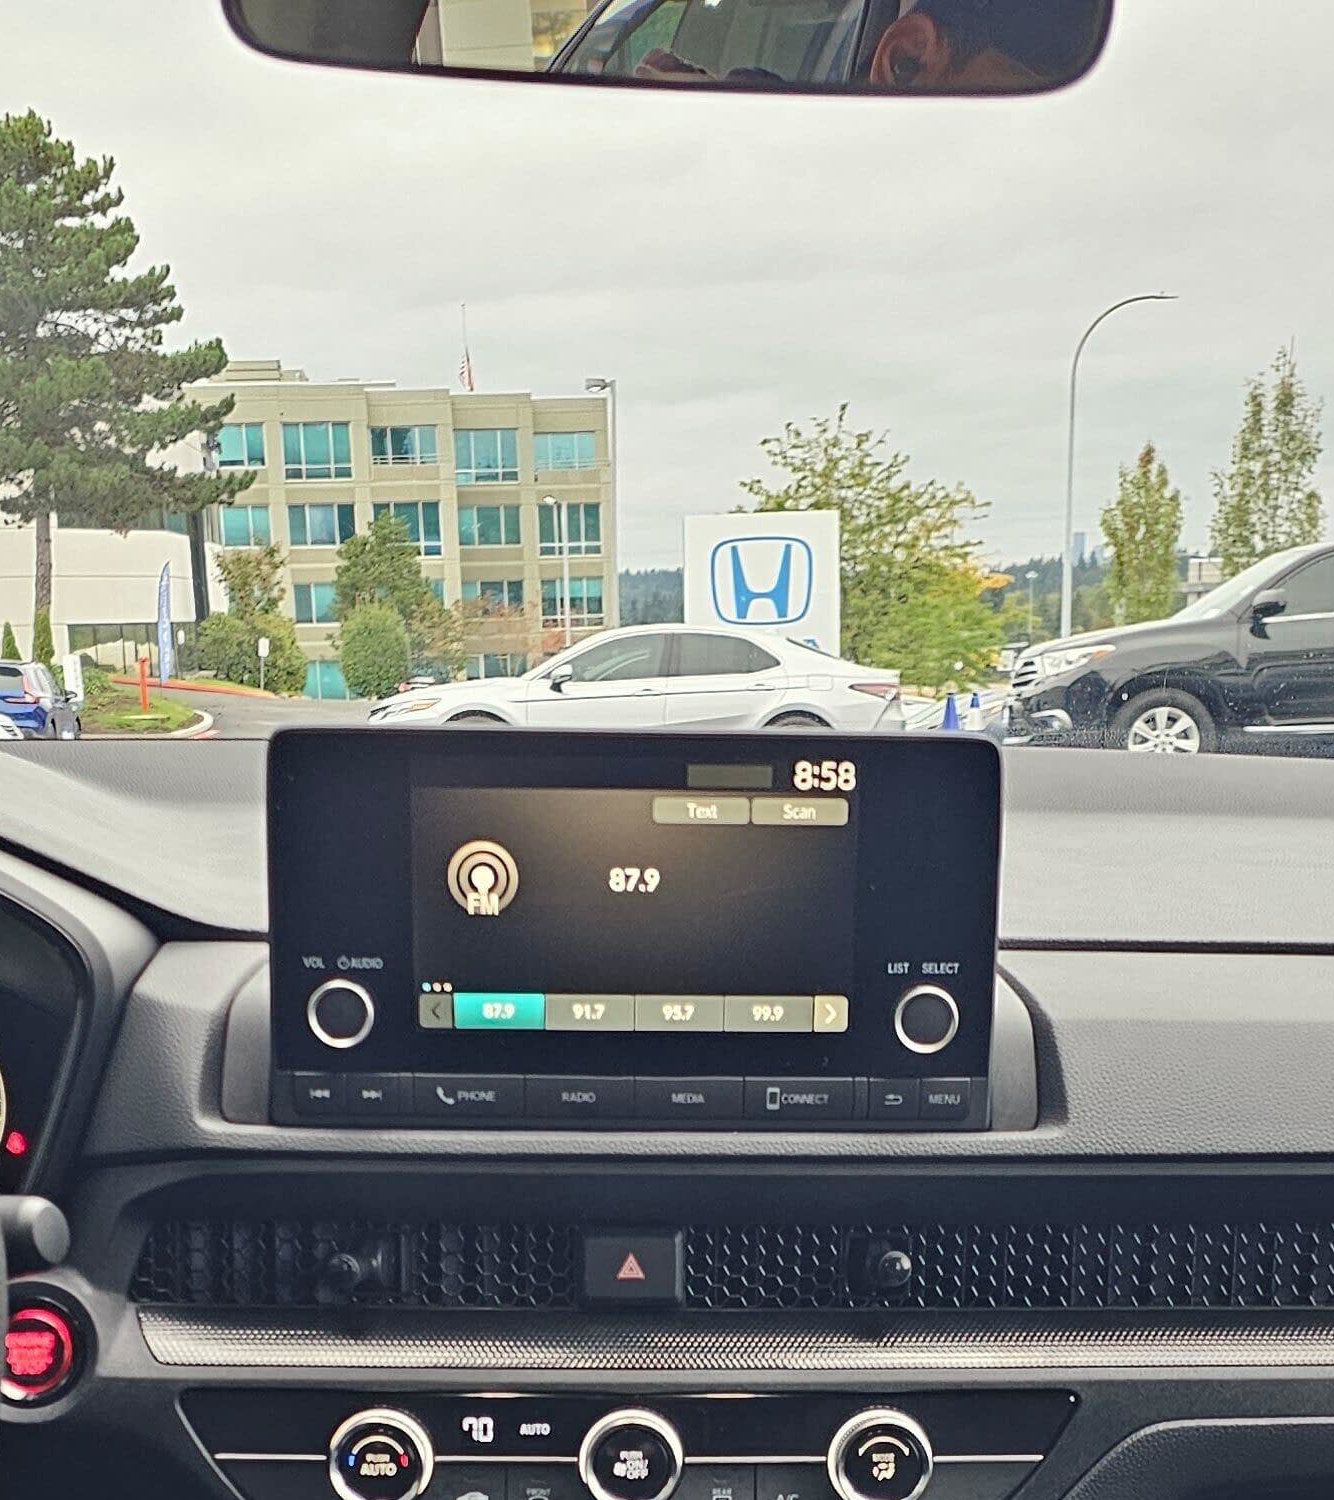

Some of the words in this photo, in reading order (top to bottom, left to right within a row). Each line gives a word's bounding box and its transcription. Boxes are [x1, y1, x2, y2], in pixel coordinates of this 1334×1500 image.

[793, 760, 857, 791] 8:58
[686, 803, 718, 819] Text
[782, 804, 817, 820] Scan
[609, 867, 661, 893] 87.9
[466, 893, 499, 916] FM
[302, 957, 325, 969] VOL
[352, 957, 383, 970] AUDIO
[887, 962, 909, 975] LIST
[922, 962, 959, 975] SELECT
[482, 1003, 515, 1019] 87.9
[572, 1004, 604, 1020] 91.7
[752, 1006, 784, 1021] 99.9
[457, 1090, 496, 1103] PHONE
[562, 1091, 596, 1104] RADIO
[672, 1092, 705, 1105] MEDIA
[781, 1092, 829, 1106] CONNECT
[928, 1093, 961, 1106] MENU
[462, 1416, 494, 1442] 70
[519, 1423, 551, 1436] AUTO
[360, 1462, 398, 1477] AUTO
[526, 1488, 551, 1496] FRONT
[712, 1488, 732, 1496] REAR
